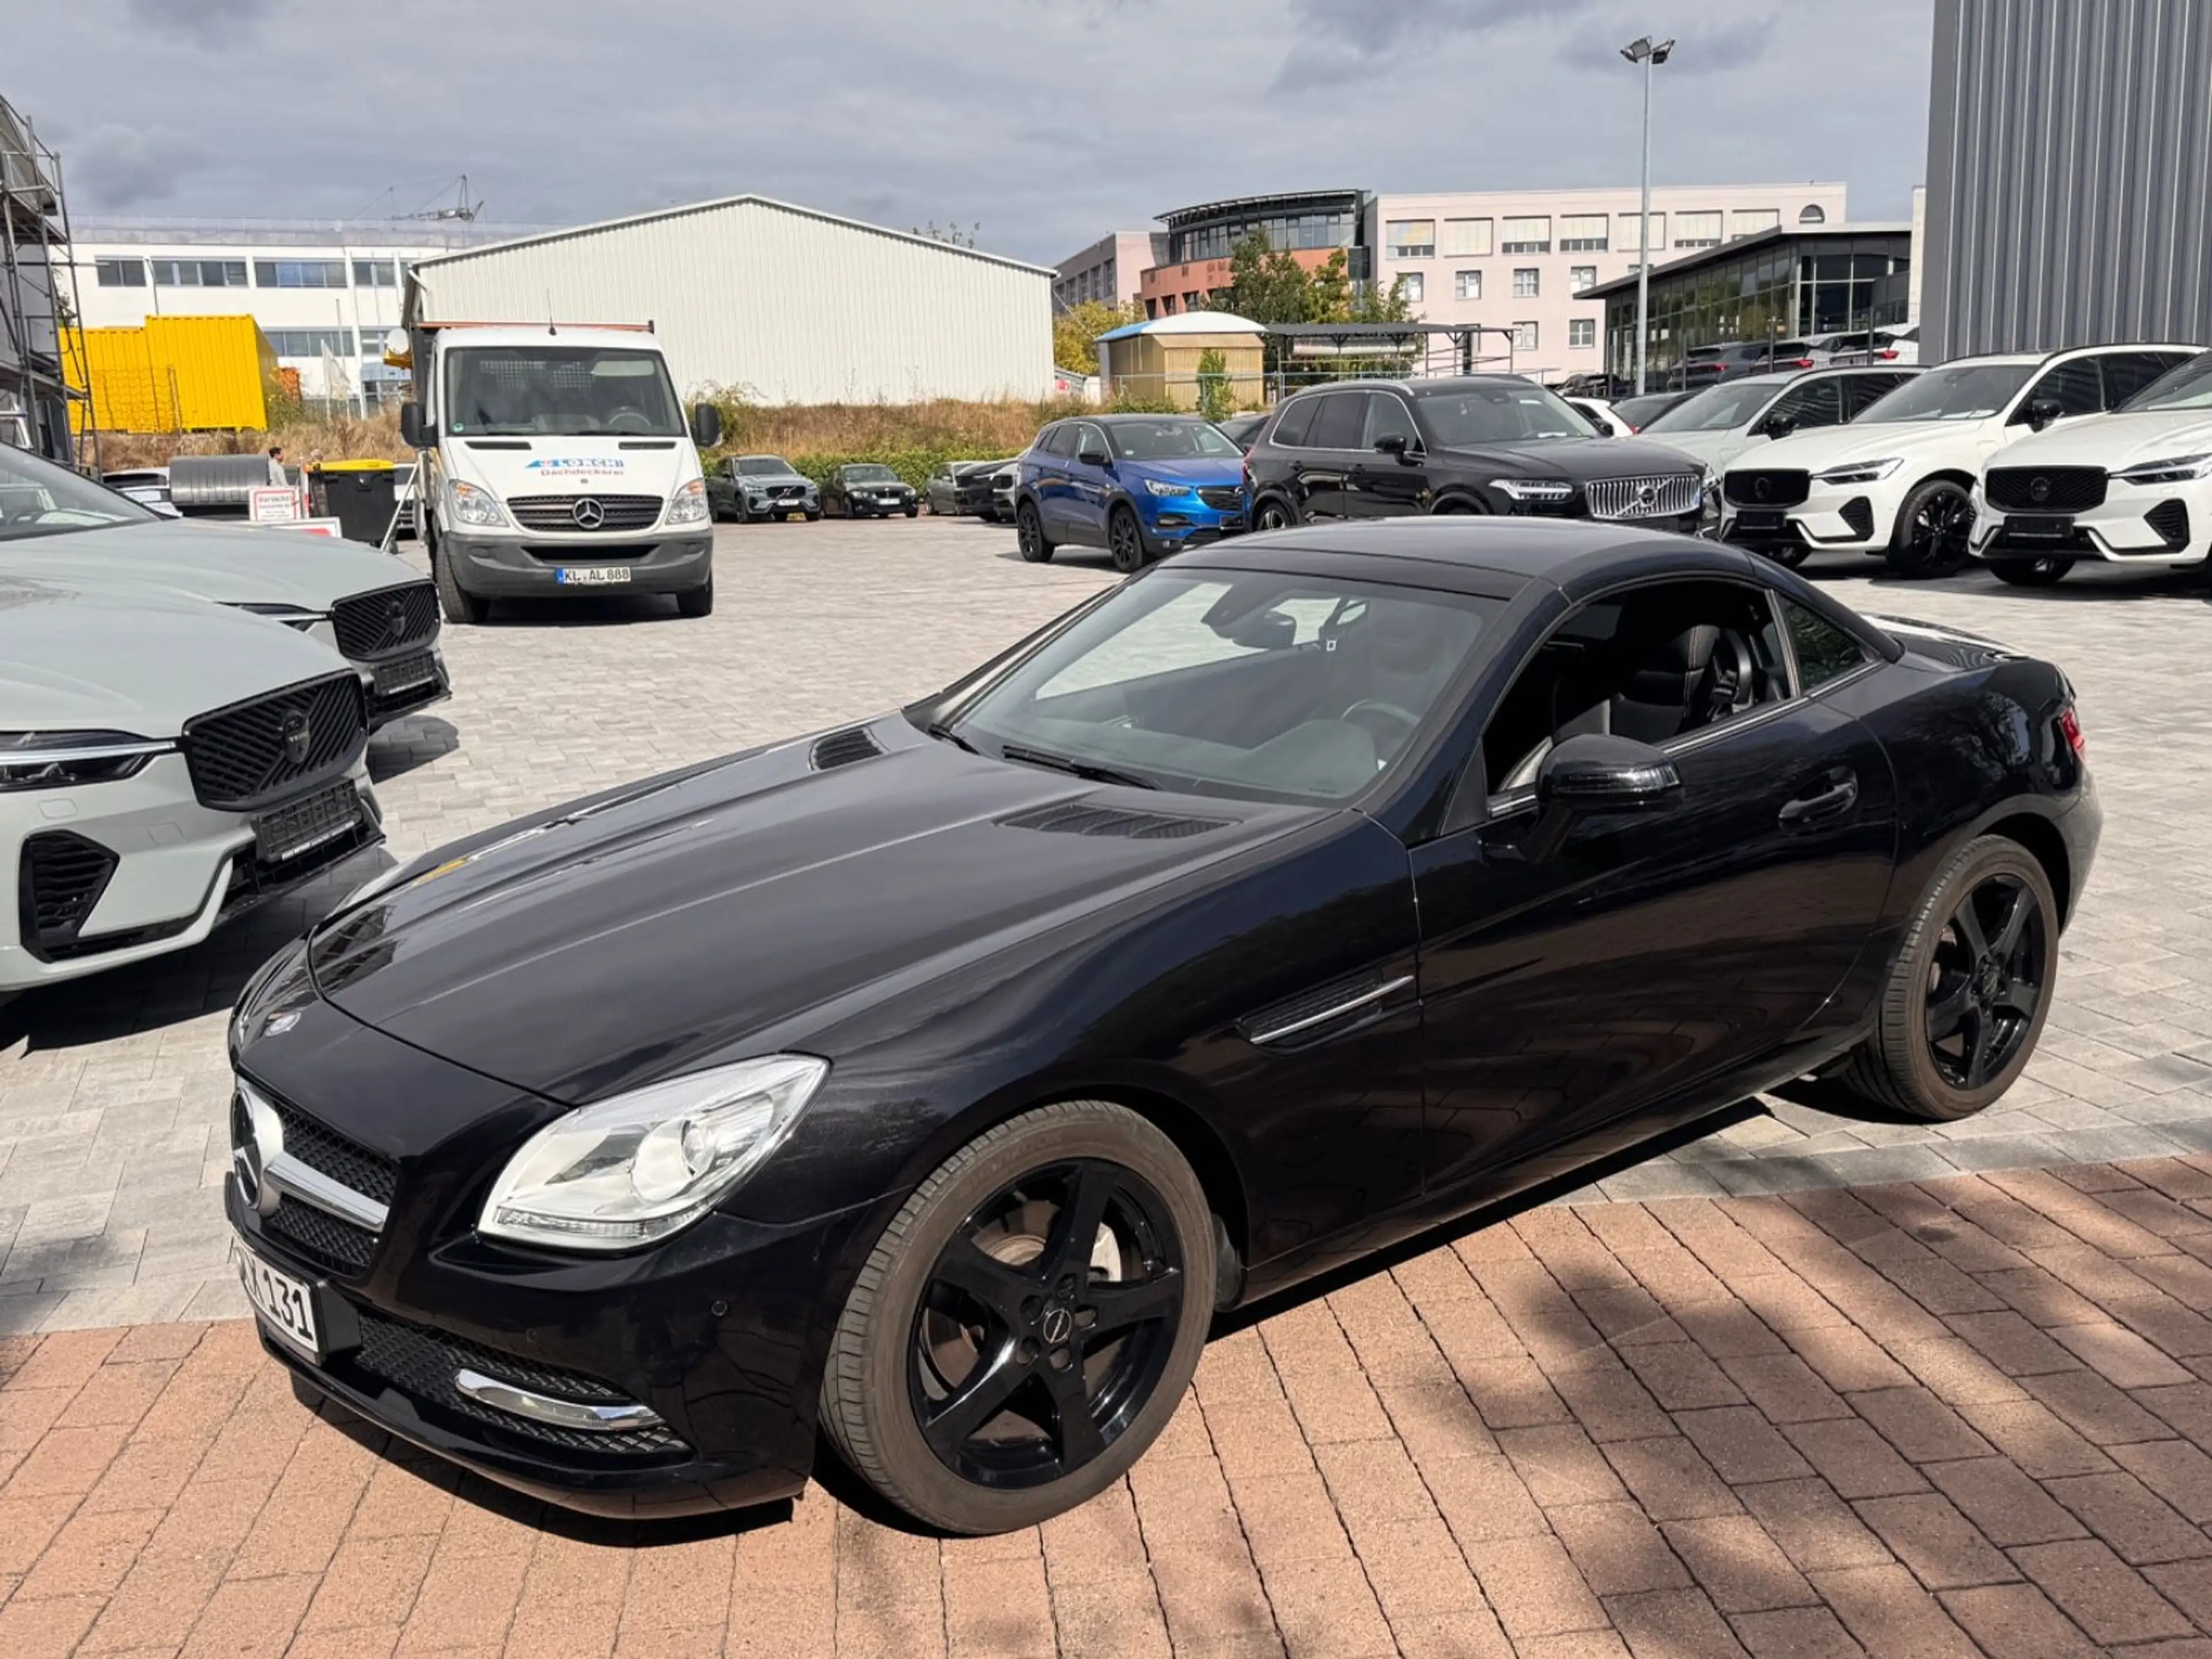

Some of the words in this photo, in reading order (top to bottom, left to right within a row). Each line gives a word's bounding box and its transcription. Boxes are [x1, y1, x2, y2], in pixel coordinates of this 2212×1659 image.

[565, 569, 581, 581] KL
[589, 568, 605, 580] AL
[607, 567, 628, 580] 888
[263, 1268, 314, 1341] 131
